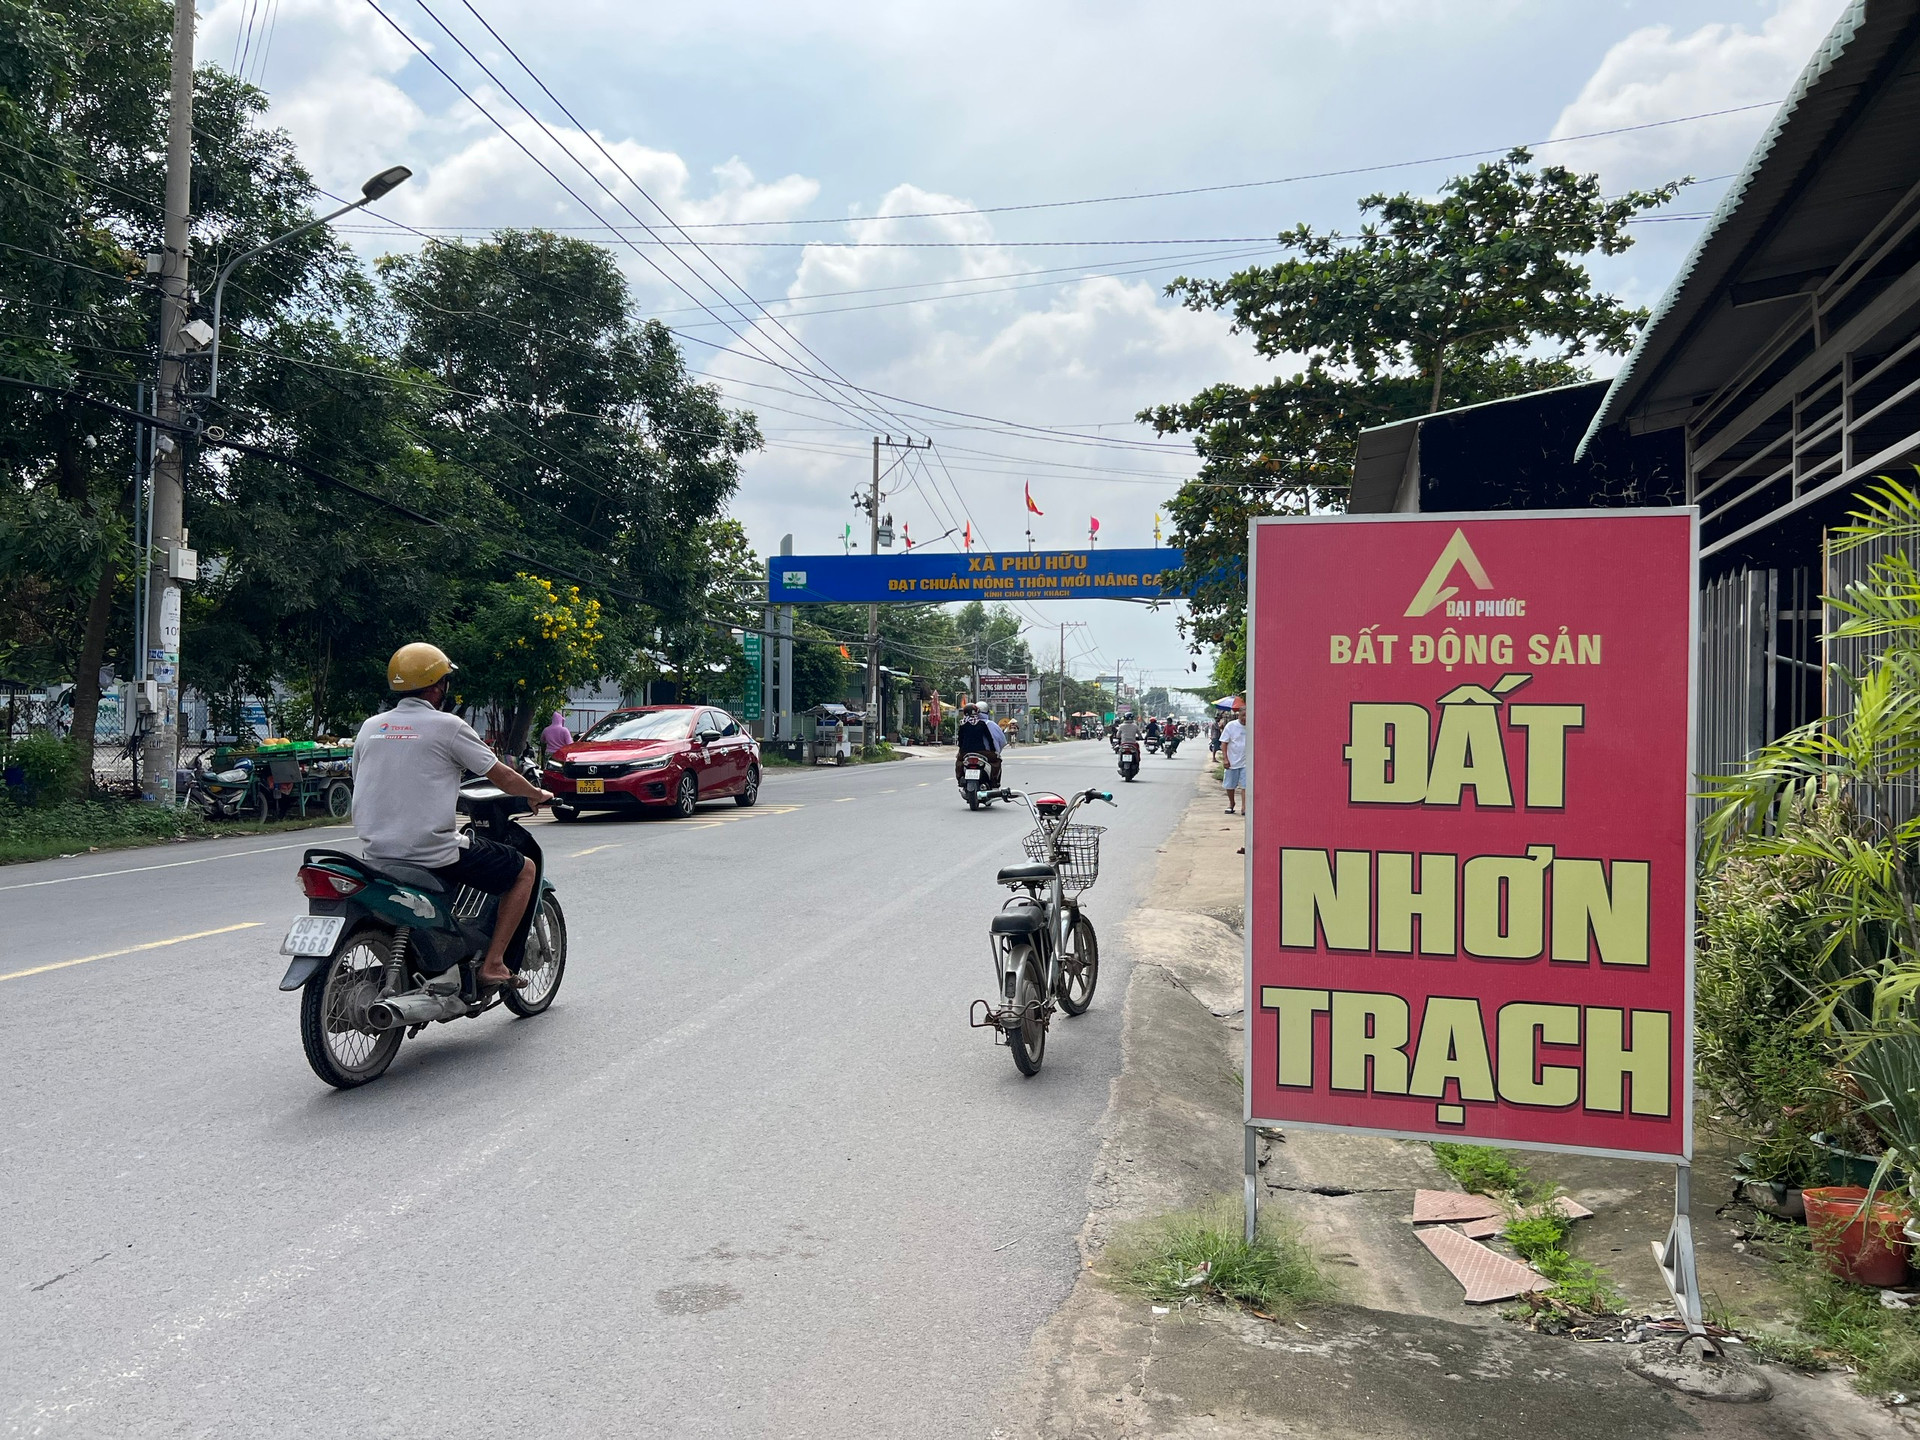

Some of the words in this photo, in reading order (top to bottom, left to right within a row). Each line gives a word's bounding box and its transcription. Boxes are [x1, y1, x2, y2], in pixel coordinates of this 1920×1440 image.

[968, 555, 996, 572] XÃ
[1002, 553, 1041, 571] PHÚ
[1045, 552, 1087, 570] HỮU
[888, 579, 917, 593] ĐẠT
[920, 572, 970, 591] CHUẨN
[973, 574, 1014, 589] NÔNG
[1018, 573, 1058, 588] THÔN
[1061, 572, 1091, 587] MỚI
[1094, 572, 1138, 587] NÂNG
[1142, 573, 1163, 587] CA
[1445, 599, 1471, 618] ĐẠI
[1474, 596, 1526, 618] PHƯỚC
[1330, 624, 1399, 665] BẤT
[1410, 628, 1514, 672] ĐỘNG
[1527, 626, 1602, 666] SẢN
[1342, 672, 1586, 810] ĐẤT
[1279, 843, 1651, 968] NHƠN
[290, 935, 329, 953] 5668
[1260, 985, 1673, 1126] TRẠCH
